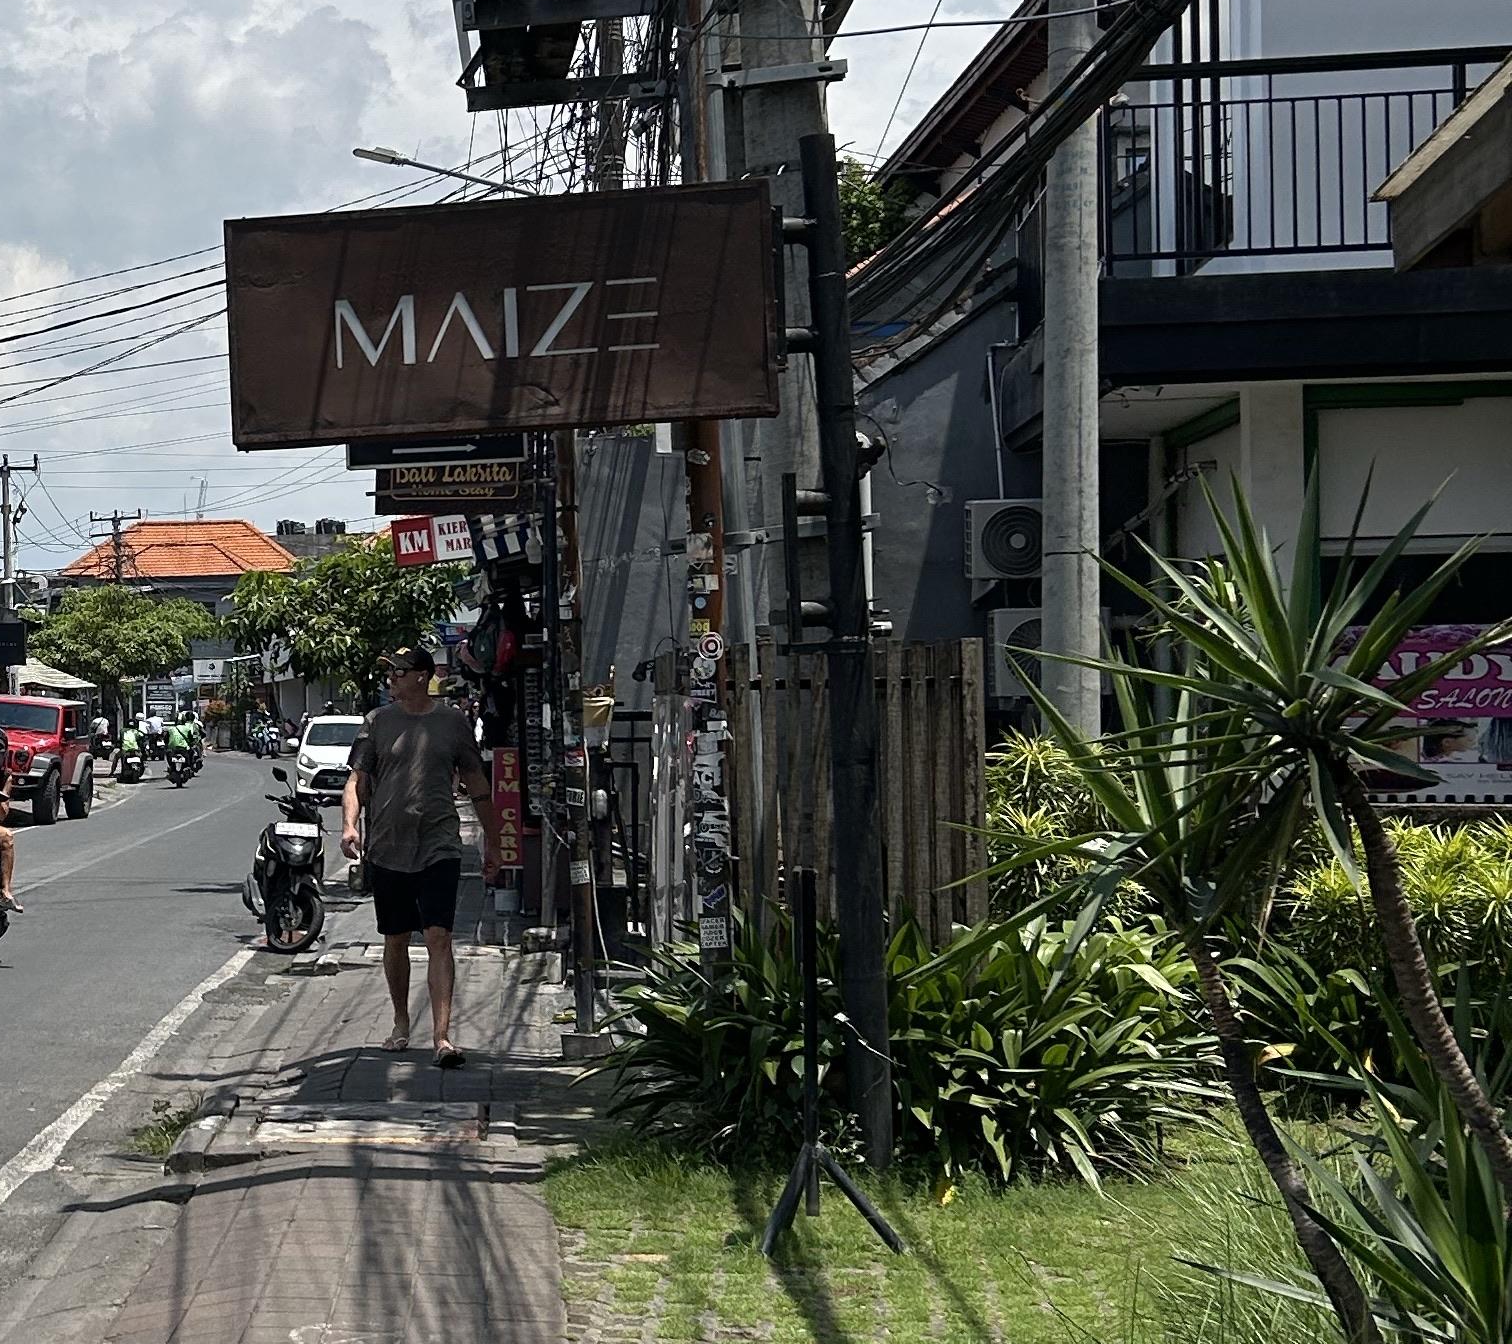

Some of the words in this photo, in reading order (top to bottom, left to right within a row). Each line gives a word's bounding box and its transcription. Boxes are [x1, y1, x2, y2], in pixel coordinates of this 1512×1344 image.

[334, 276, 660, 369] MAIZE
[396, 464, 437, 484] Bali
[442, 462, 514, 483] Laksita
[397, 529, 431, 555] KM
[1417, 687, 1512, 709] SALON
[497, 752, 521, 793] SIM
[499, 808, 519, 862] CARD
